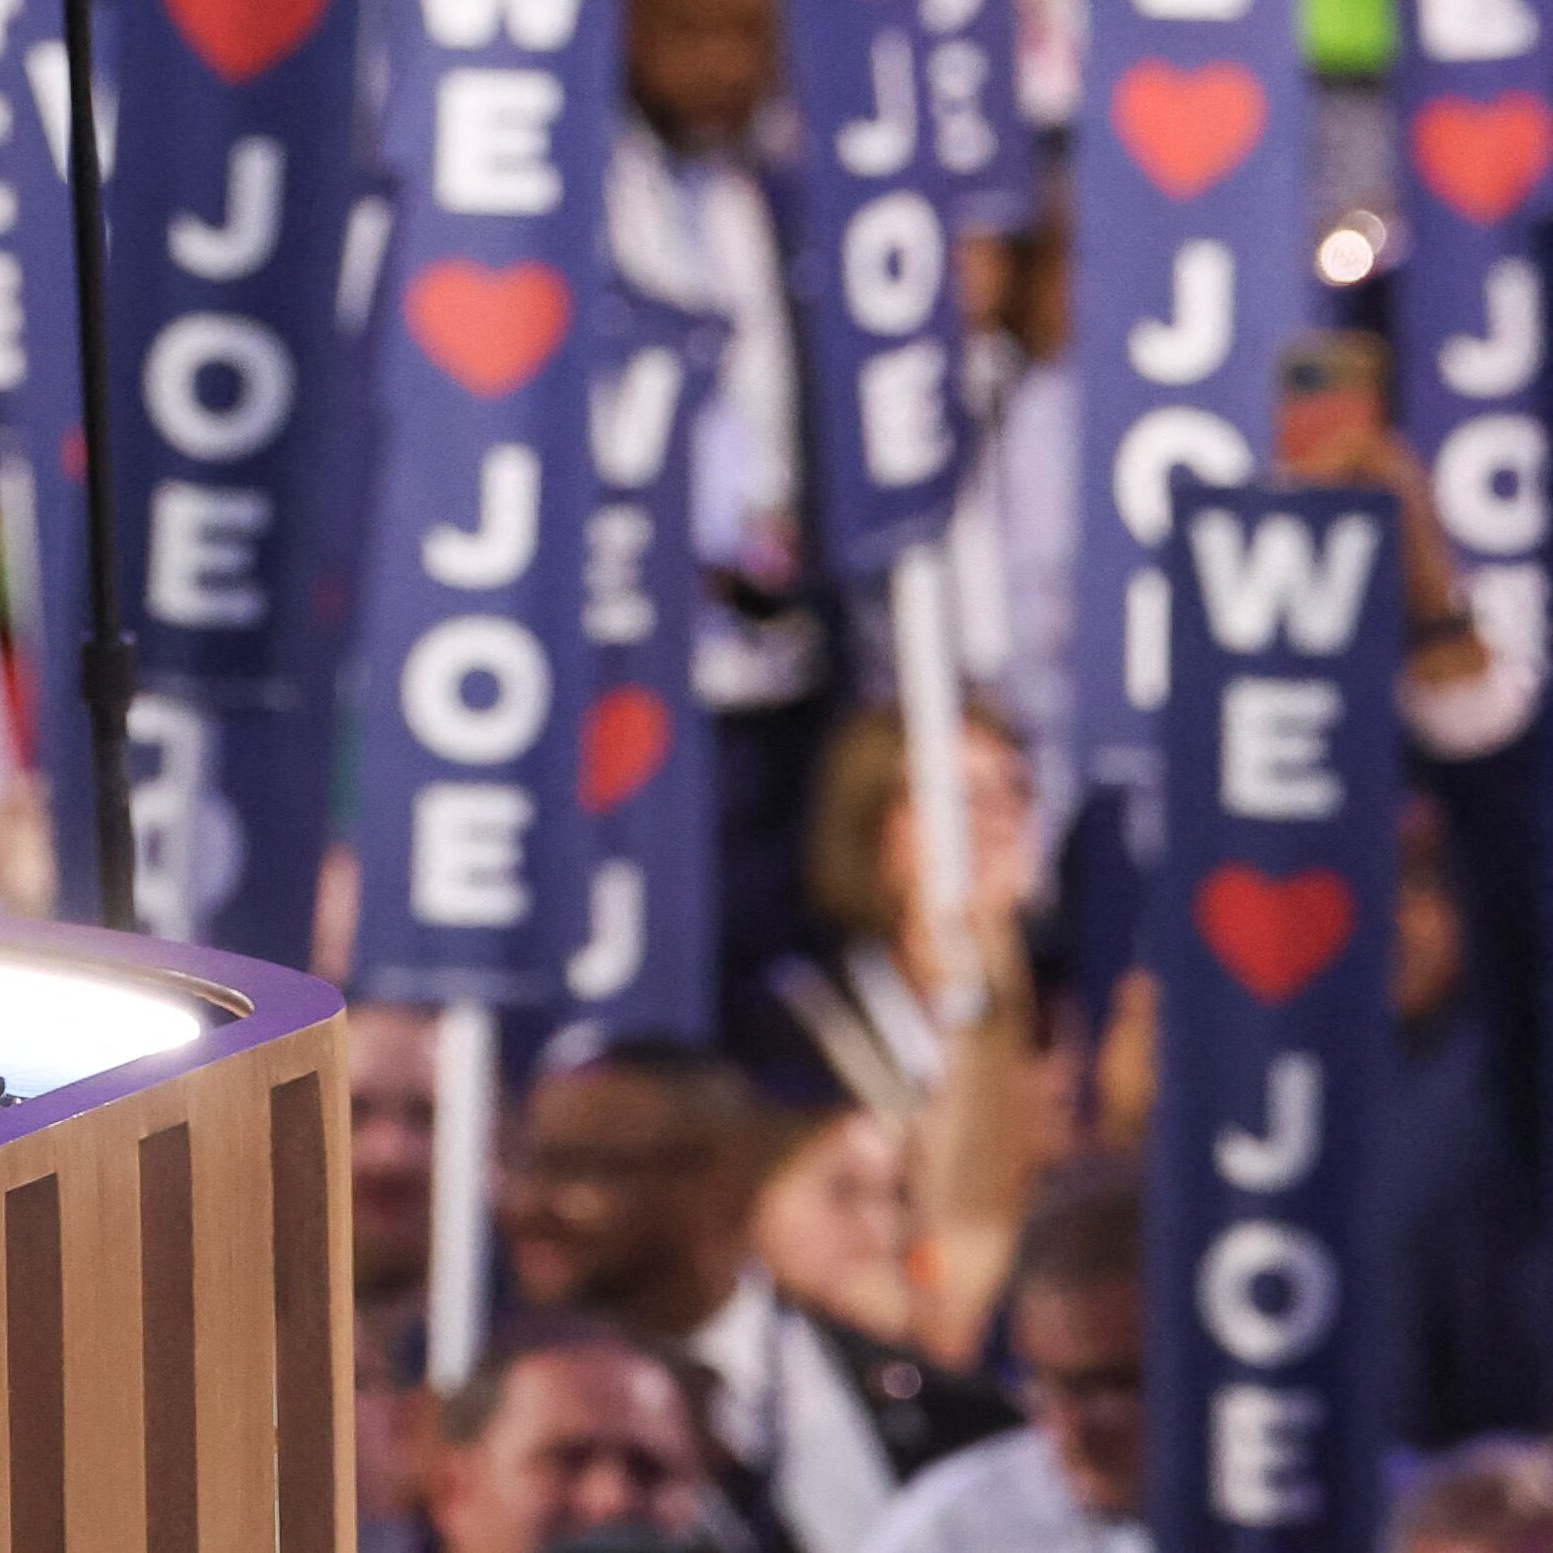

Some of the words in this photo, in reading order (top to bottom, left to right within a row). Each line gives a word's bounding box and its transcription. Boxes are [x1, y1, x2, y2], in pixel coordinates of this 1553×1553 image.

[142, 137, 294, 629] JOE
[834, 26, 956, 488] JOE
[400, 444, 553, 929] JOE
[1188, 506, 1381, 823] WE
[1194, 1049, 1341, 1529] JOE
